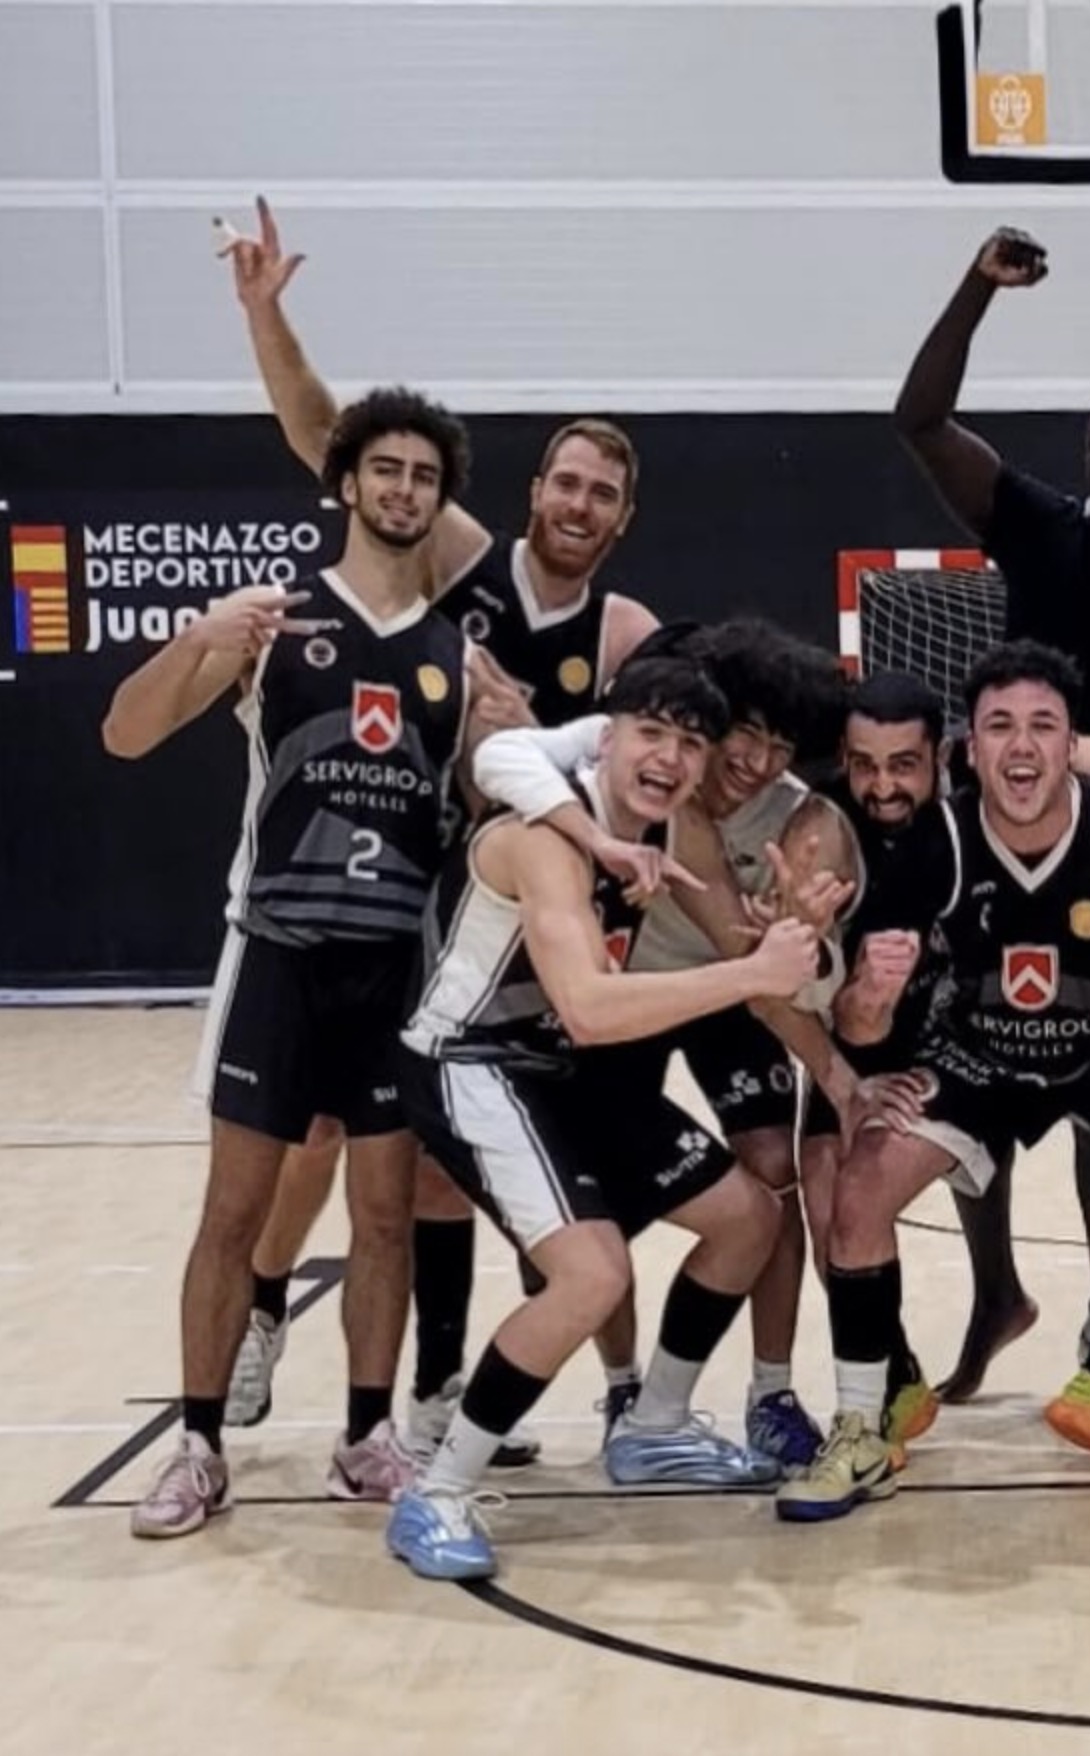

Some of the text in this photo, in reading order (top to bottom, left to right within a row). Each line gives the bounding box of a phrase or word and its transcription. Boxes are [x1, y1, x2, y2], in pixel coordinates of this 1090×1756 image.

[83, 522, 321, 554] MECENAZGO
[85, 557, 297, 588] DEPORTIVO
[347, 828, 383, 881] 2
